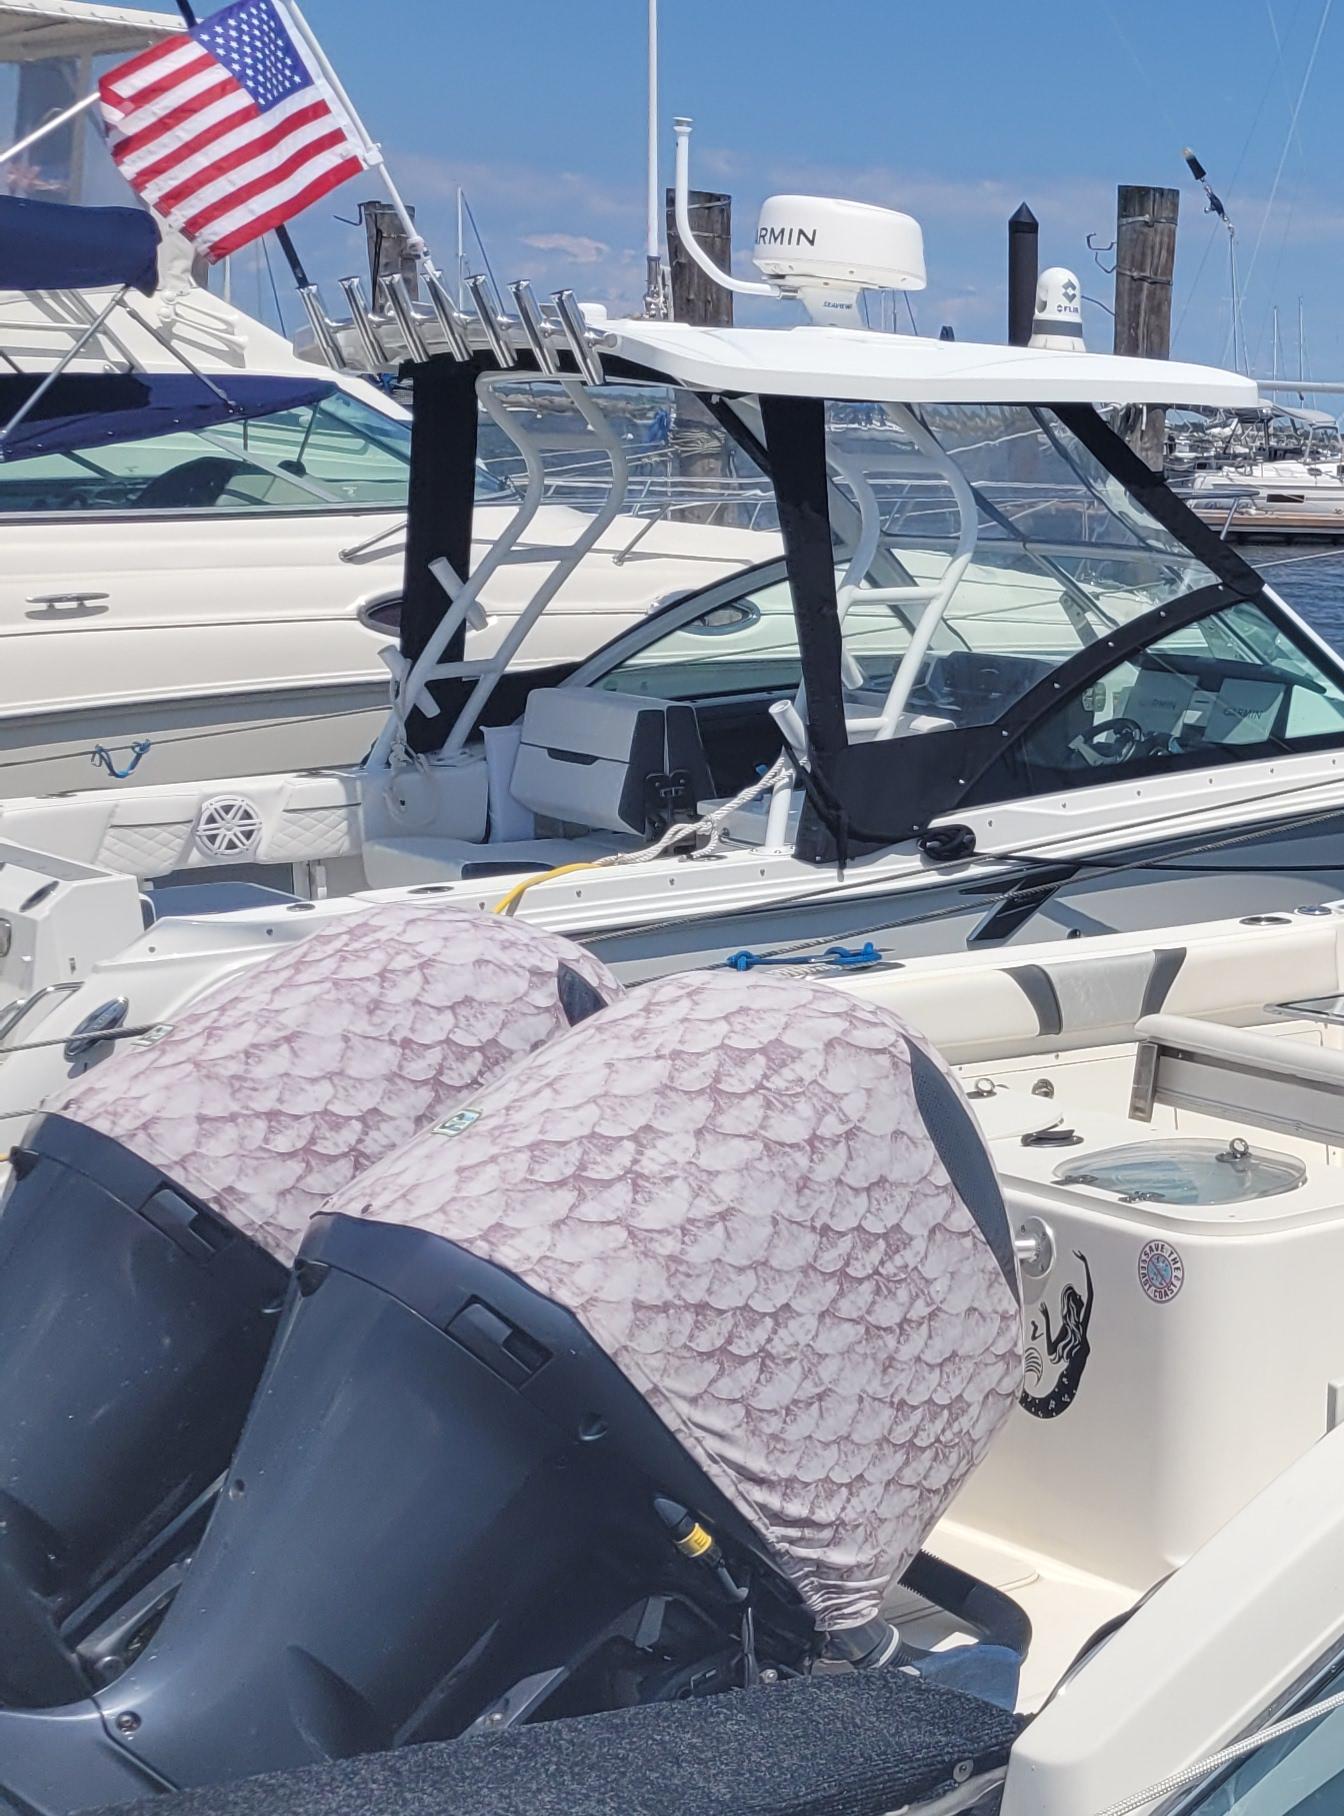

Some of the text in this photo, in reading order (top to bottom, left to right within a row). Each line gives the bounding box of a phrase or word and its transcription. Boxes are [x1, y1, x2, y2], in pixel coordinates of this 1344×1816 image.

[755, 226, 817, 247] RMIN
[1143, 1242, 1182, 1274] SAVE THE
[1153, 1279, 1178, 1300] COAST
